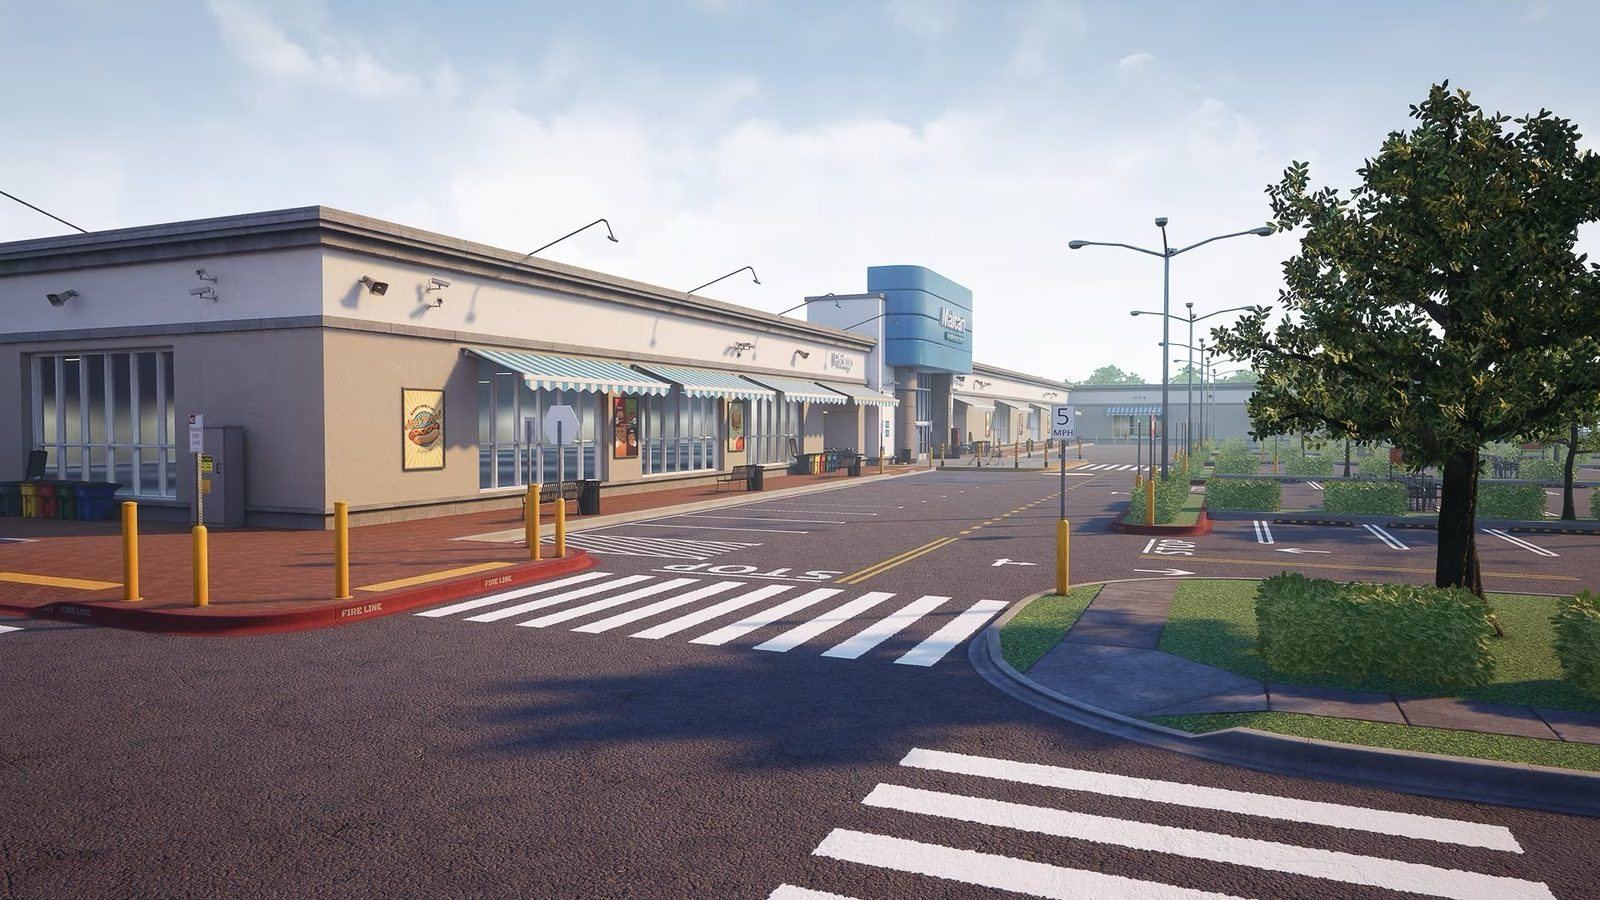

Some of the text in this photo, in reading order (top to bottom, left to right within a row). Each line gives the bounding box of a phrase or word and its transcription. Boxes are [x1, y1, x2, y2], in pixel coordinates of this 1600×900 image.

[1057, 408, 1069, 425] 5
[1054, 429, 1073, 437] MPH
[1154, 539, 1196, 556] STOP
[663, 563, 844, 580] STOP
[485, 575, 512, 587] FIRE LINE
[342, 603, 382, 617] FIRE LINE
